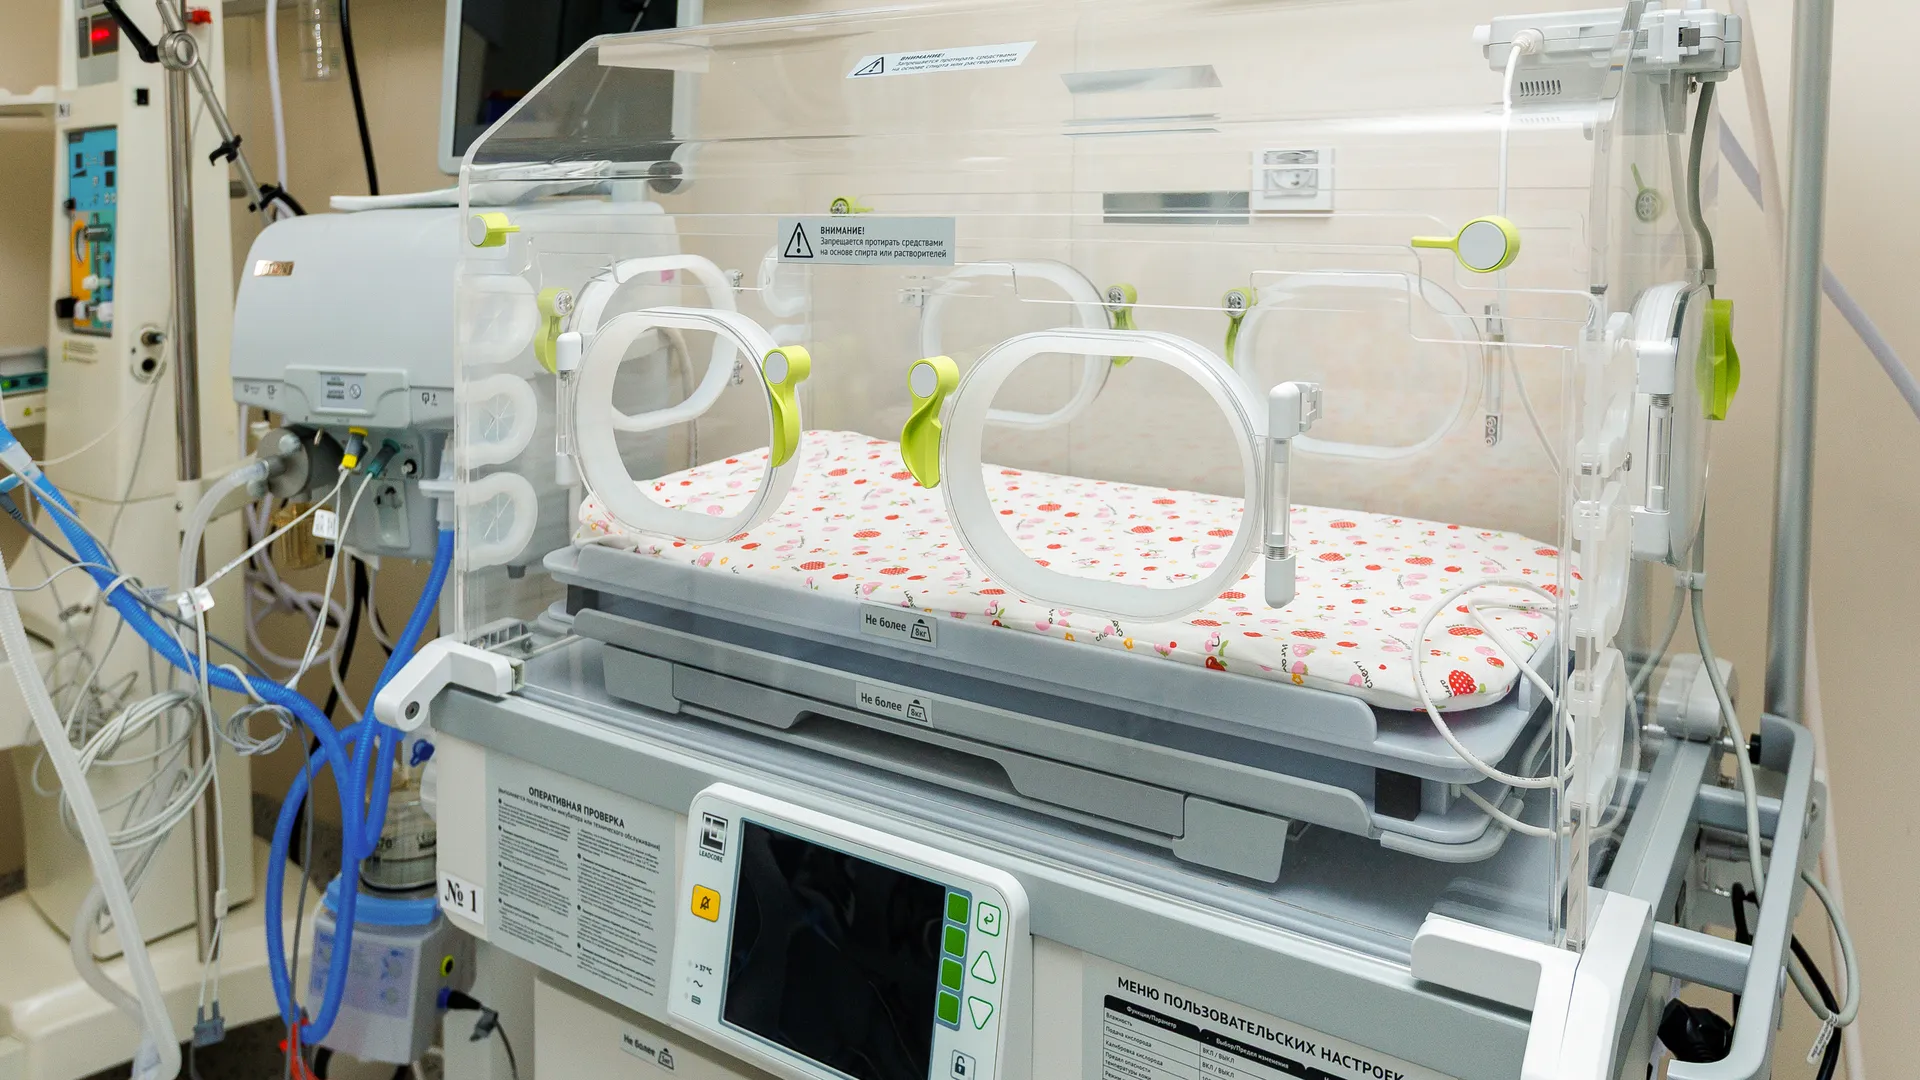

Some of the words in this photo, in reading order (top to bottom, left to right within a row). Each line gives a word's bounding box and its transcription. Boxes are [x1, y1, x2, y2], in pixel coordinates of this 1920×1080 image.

[900, 53, 945, 61] ВНИМАНИЕ!
[820, 226, 865, 235] ВНИМАНИЕ!
[820, 236, 864, 247] Запрещается
[864, 239, 901, 247] протирать
[901, 239, 944, 248] средствами
[854, 249, 878, 258] спирта
[893, 249, 947, 259] растворителей
[865, 613, 878, 626] Не
[879, 617, 907, 632] более
[914, 627, 928, 638] 8кг
[861, 692, 874, 705] Не
[874, 696, 903, 712] более
[910, 708, 924, 718] 8кг
[528, 786, 582, 814] ОПЕРАТИВНАЯ
[583, 805, 625, 829] ПРОВЕРКА
[699, 850, 723, 863] LEADCORE
[444, 878, 464, 908] №
[470, 889, 477, 914] 1
[1105, 1012, 1133, 1027] Влажность
[1117, 976, 1160, 1001] МЕНЮ
[1163, 991, 1316, 1057] ПОЛЬЗОВАТЕЛЬСКИХ
[1105, 1026, 1124, 1038] Подача
[1125, 1034, 1152, 1048] кислорода
[1105, 1040, 1135, 1056] Калибровка
[1136, 1052, 1164, 1067] кислорода
[1105, 1051, 1124, 1063] Предел
[1202, 1047, 1214, 1058] ВКЛ
[1218, 1053, 1235, 1064] ВЫКЛ
[1216, 1037, 1258, 1058] Выбор/Предел
[1258, 1053, 1289, 1069] изменения
[1202, 1061, 1214, 1072] ВКЛ
[1218, 1067, 1235, 1078] ВЫКЛ
